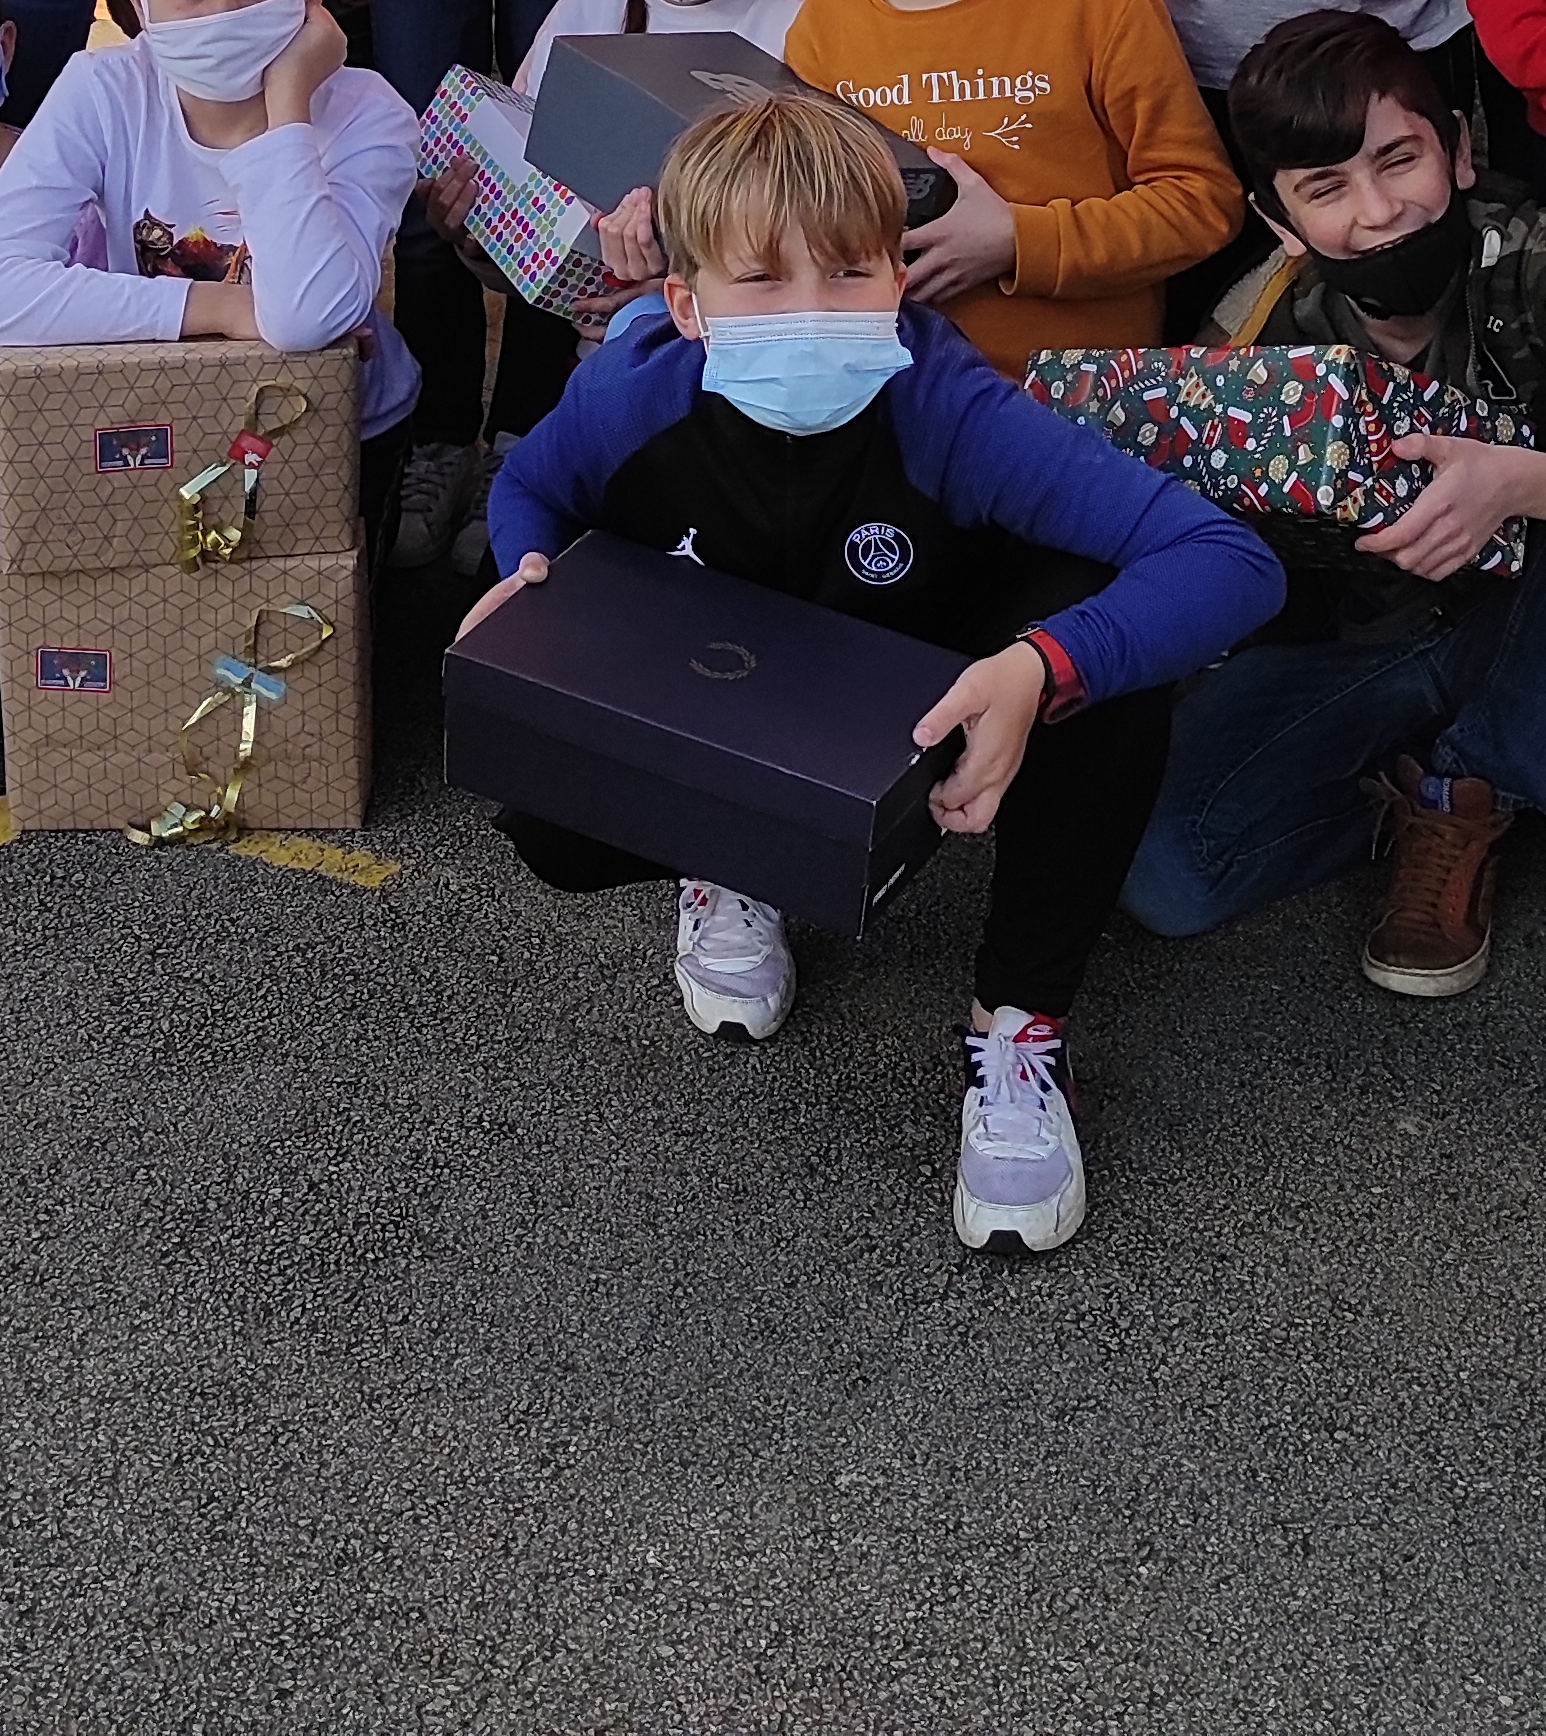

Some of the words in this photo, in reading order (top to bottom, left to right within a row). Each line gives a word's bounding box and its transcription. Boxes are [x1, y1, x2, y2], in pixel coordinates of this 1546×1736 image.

[835, 74, 912, 108] Good
[921, 68, 1051, 105] Things
[935, 112, 972, 150] day
[852, 526, 895, 544] PARIS
